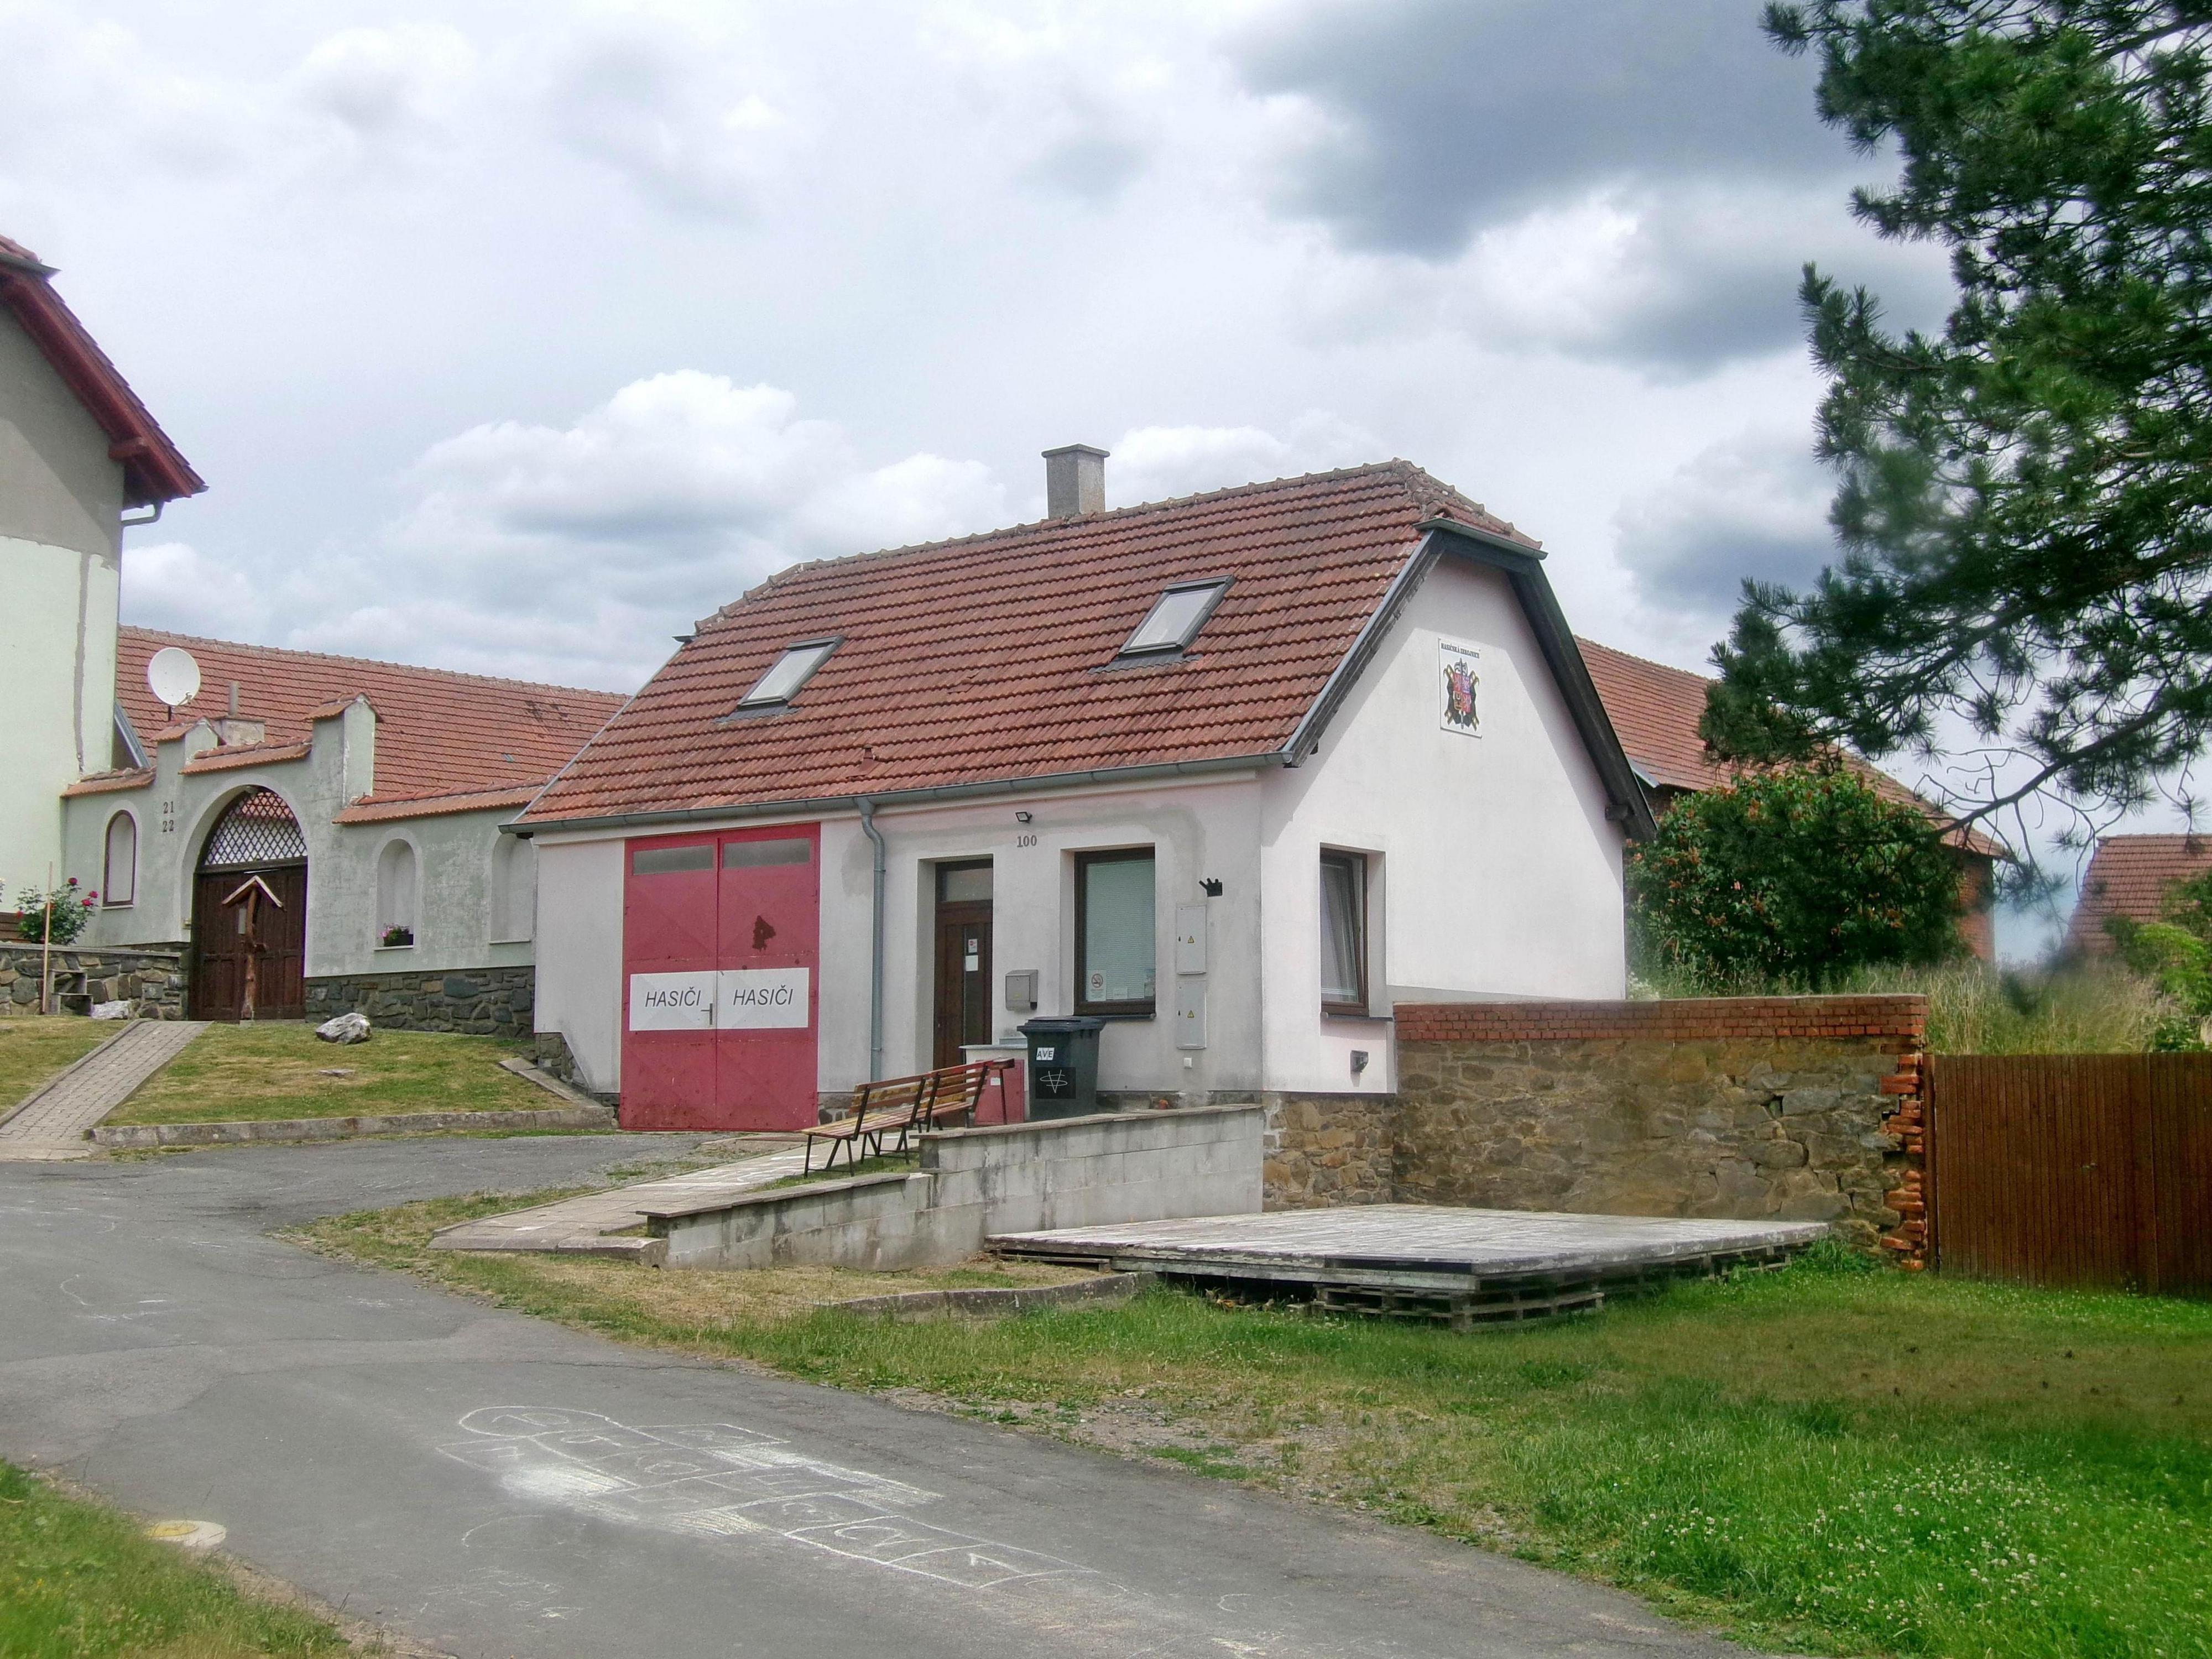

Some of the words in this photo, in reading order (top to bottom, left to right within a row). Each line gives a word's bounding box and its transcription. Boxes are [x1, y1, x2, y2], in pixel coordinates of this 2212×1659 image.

[163, 801, 174, 813] 21
[163, 820, 174, 833] 22
[1016, 834, 1037, 848] 100
[645, 987, 701, 1008] HASIČI
[733, 984, 794, 1005] HASIČI
